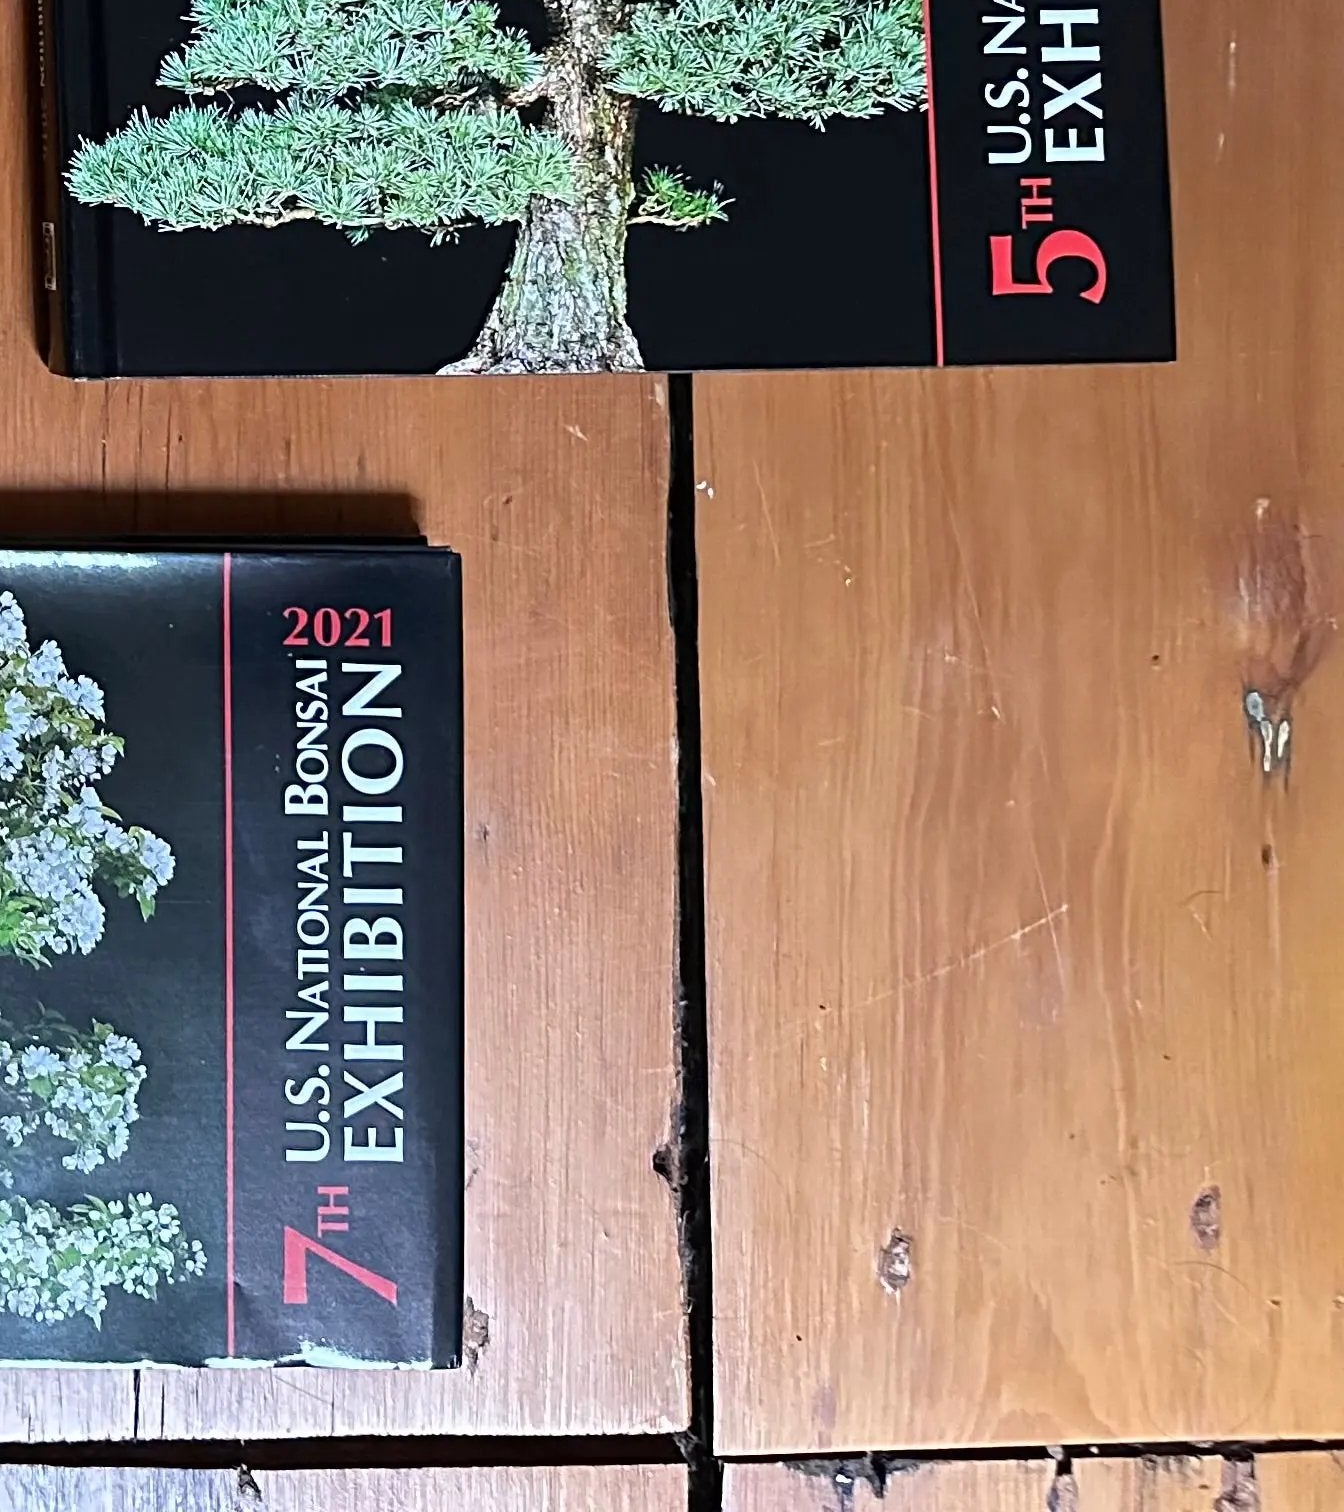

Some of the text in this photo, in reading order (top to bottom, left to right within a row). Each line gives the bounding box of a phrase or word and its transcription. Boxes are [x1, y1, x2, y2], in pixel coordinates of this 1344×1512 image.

[984, 67, 1032, 165] U.S.
[989, 177, 1108, 305] 5TH
[283, 607, 392, 647] 2021
[341, 662, 405, 1163] EXHIBITION
[283, 659, 397, 1304] 7TH U.S. NATIONAL BONSAI
